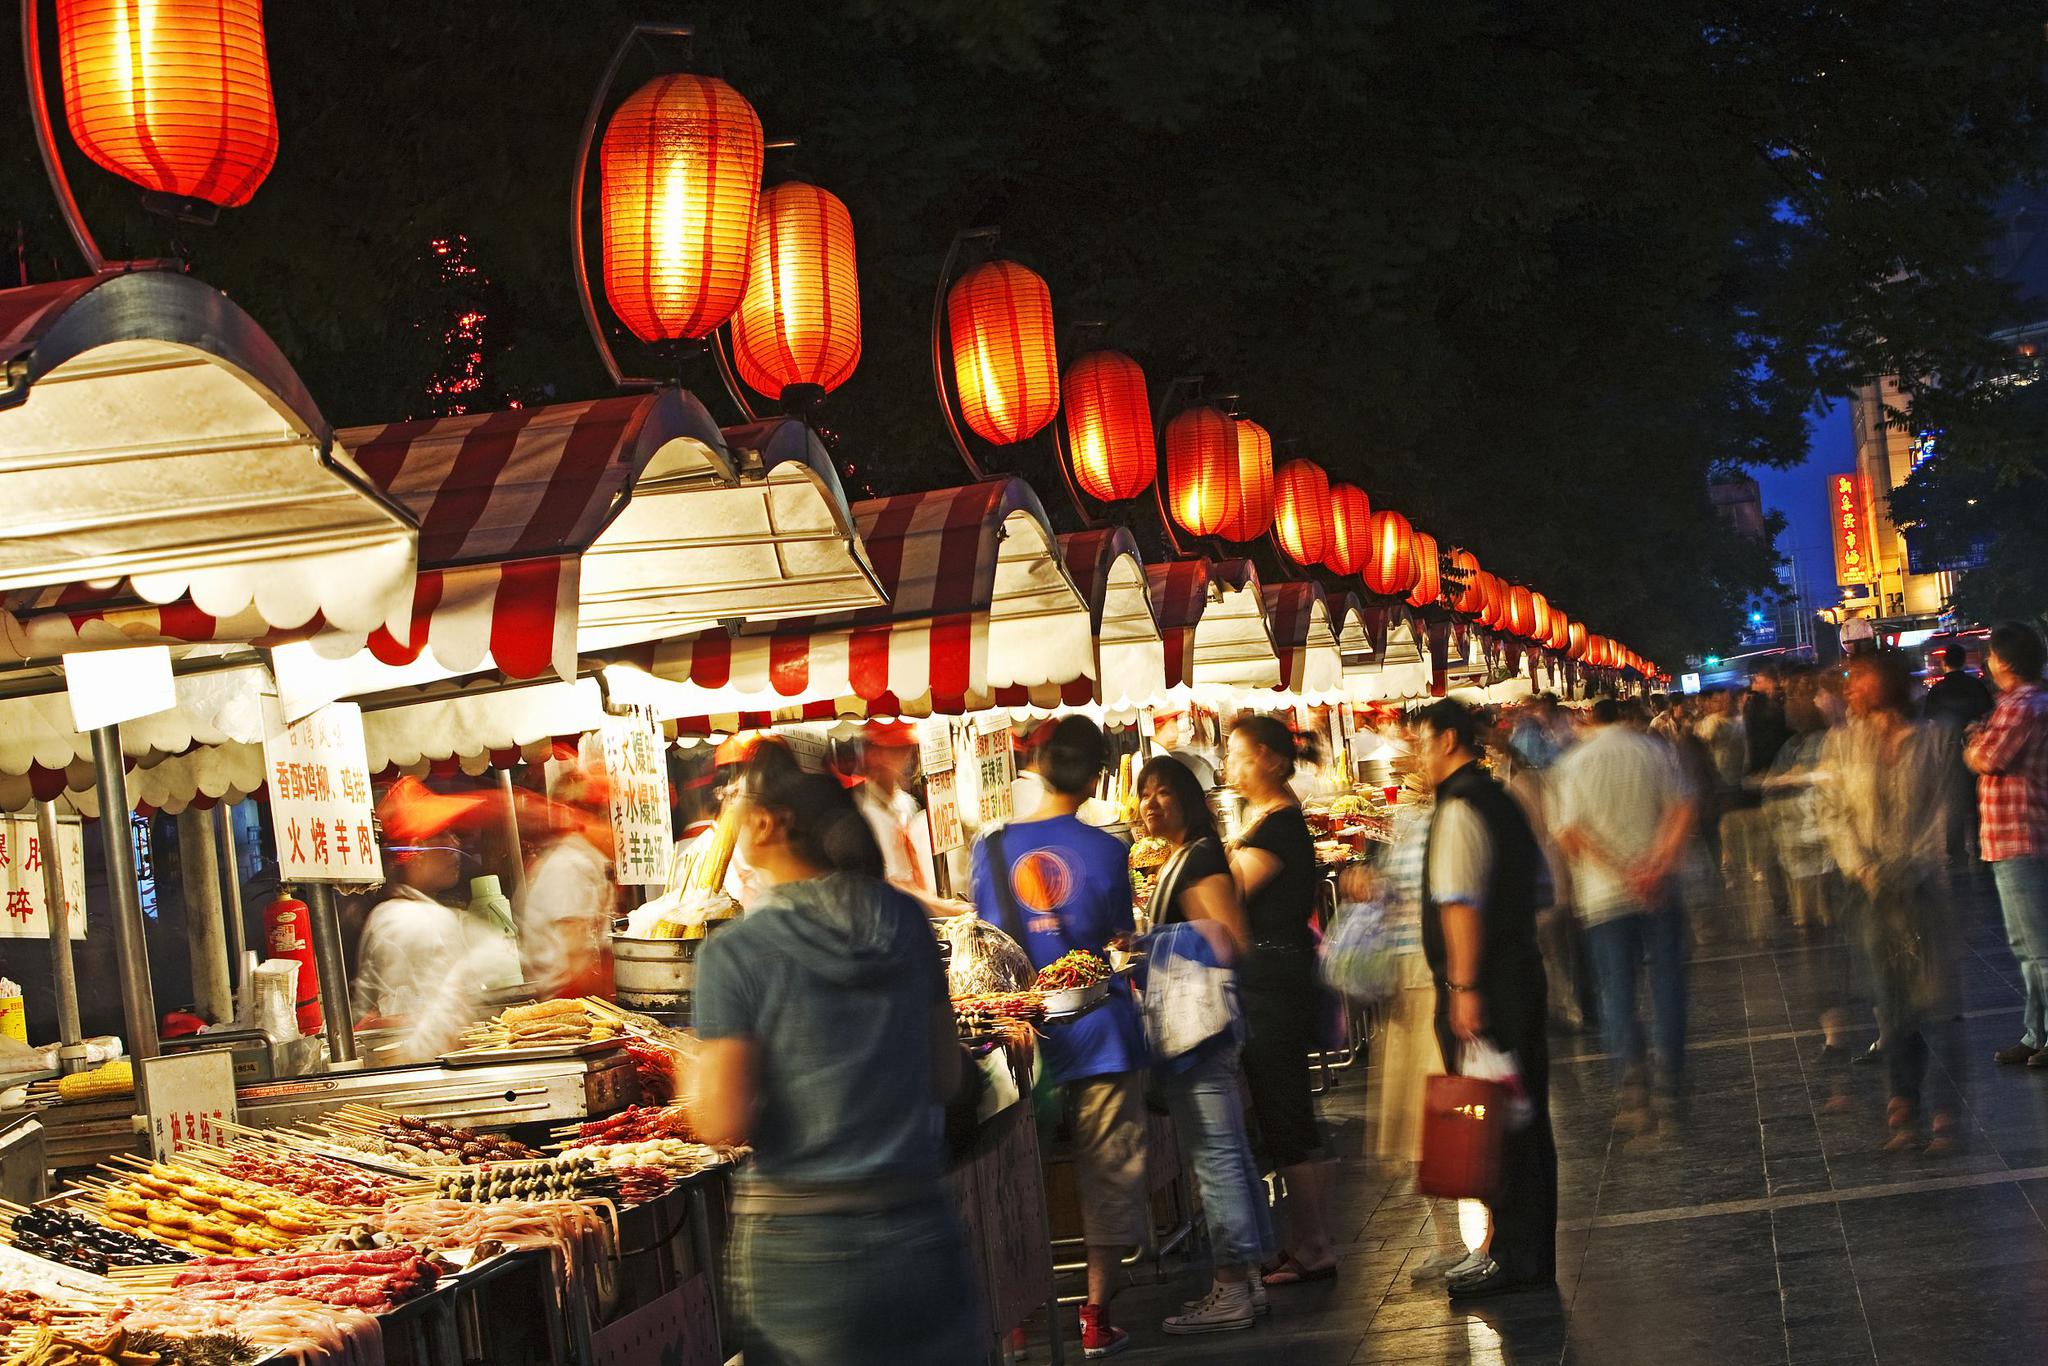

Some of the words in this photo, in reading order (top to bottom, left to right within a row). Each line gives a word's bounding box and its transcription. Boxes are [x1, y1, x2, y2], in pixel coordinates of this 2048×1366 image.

[624, 778, 662, 826] 水爆肚
[287, 817, 373, 865] 火烤羊肉
